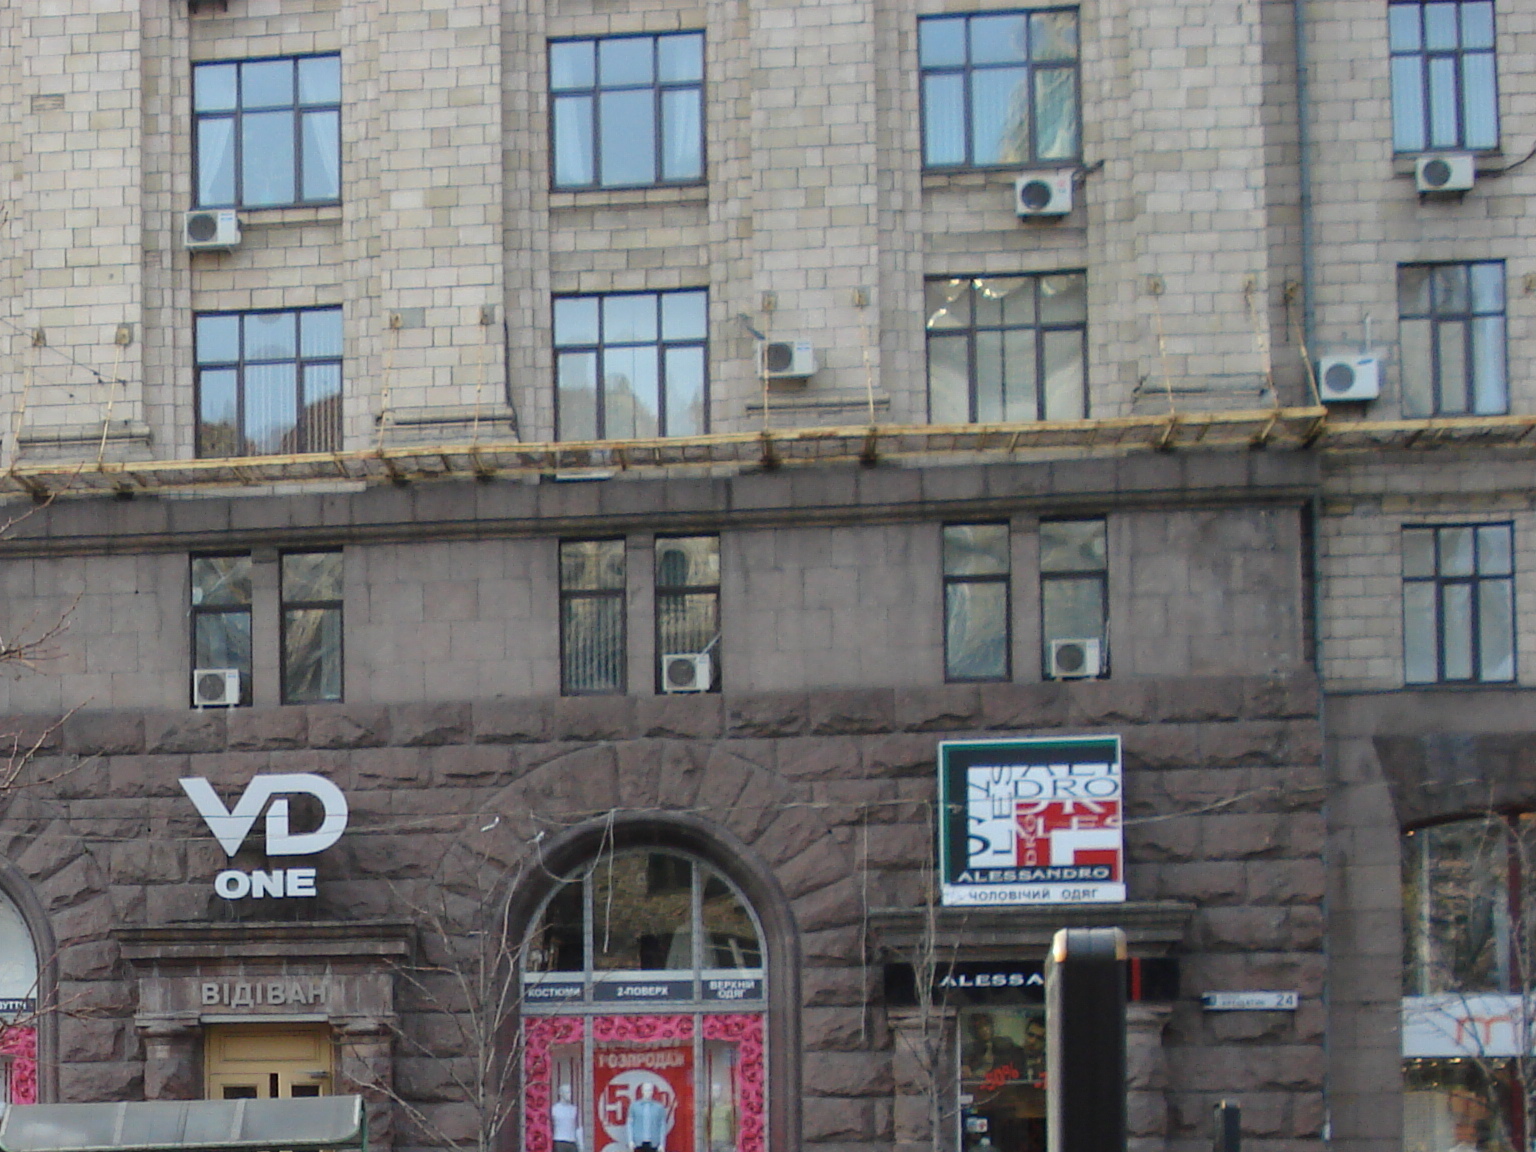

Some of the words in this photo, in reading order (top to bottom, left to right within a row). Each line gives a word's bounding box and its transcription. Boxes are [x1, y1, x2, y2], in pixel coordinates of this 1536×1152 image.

[178, 773, 349, 858] VD
[957, 867, 1111, 883] ALESSANDRO
[214, 868, 317, 900] ONE
[968, 887, 1051, 901] ЧОЛОВІЧИЙ
[1061, 888, 1100, 901] ОДЯГ
[201, 981, 327, 1009] ВІДІВАН
[527, 987, 581, 998] КОСТЮМИ
[1275, 994, 1294, 1006] 24
